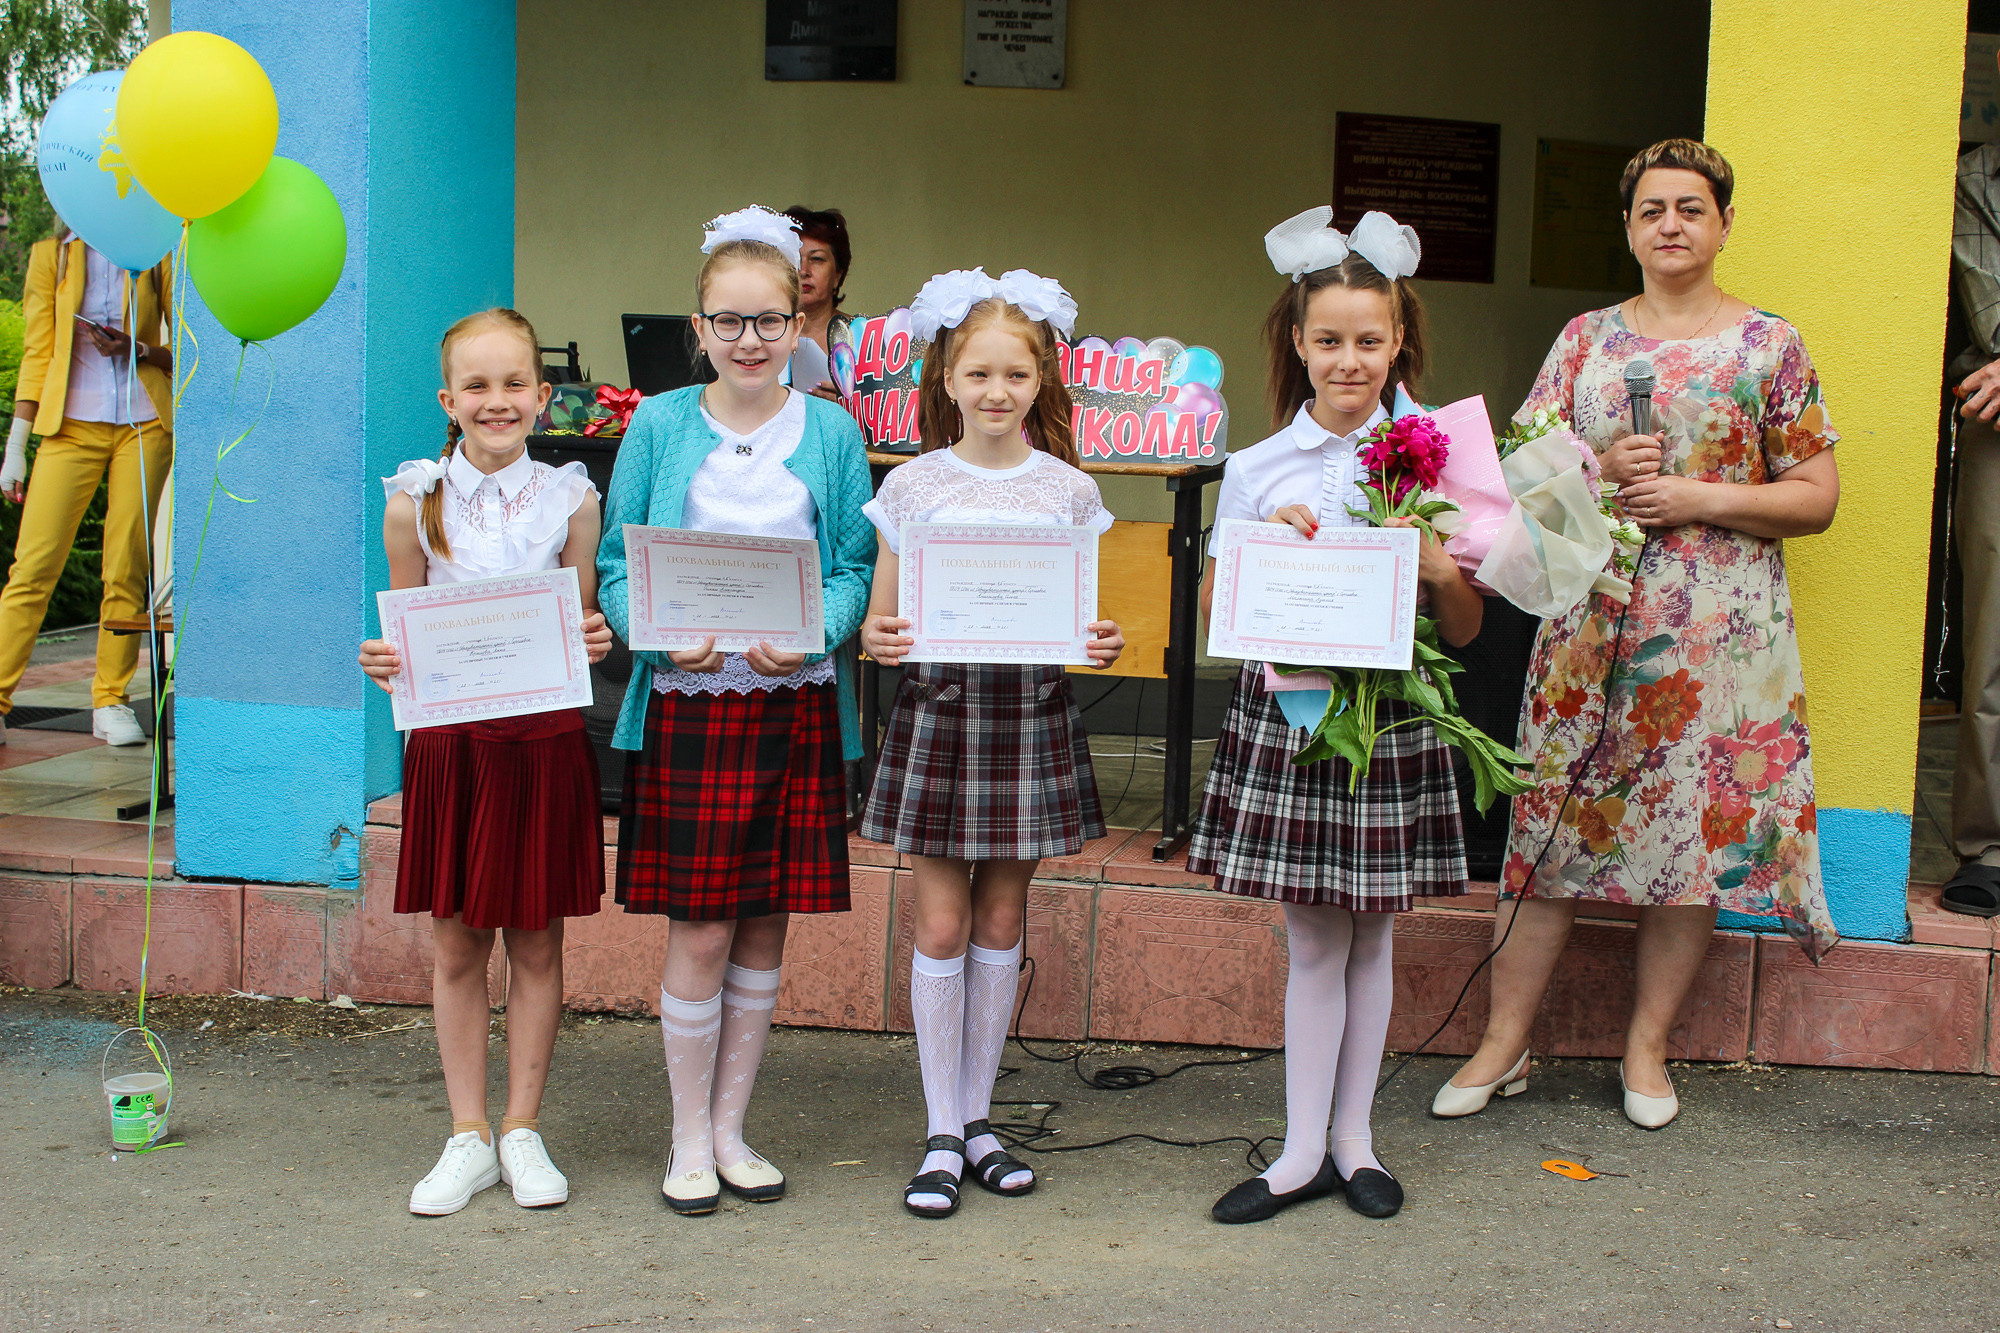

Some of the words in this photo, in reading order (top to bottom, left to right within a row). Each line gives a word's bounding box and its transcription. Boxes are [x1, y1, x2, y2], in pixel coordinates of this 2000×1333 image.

[1353, 154, 1385, 166] ВРЕМЯ
[1387, 157, 1424, 168] РАБОТЫ
[1344, 186, 1397, 198] ВЫХОДНОЙ
[666, 555, 745, 569] ПОХВАЛЬНЫЙ
[750, 561, 781, 570] ЛИСТ
[941, 558, 1021, 569] ПОХВАЛЬНЫЙ
[1025, 560, 1057, 570] ЛИСТ
[1257, 558, 1340, 574] ПОХВАЛЬНЫЙ
[1343, 564, 1376, 574] ЛИСТ
[424, 611, 505, 632] ПОХВАЛЬНЫЙ
[509, 608, 541, 621] ЛИСТ
